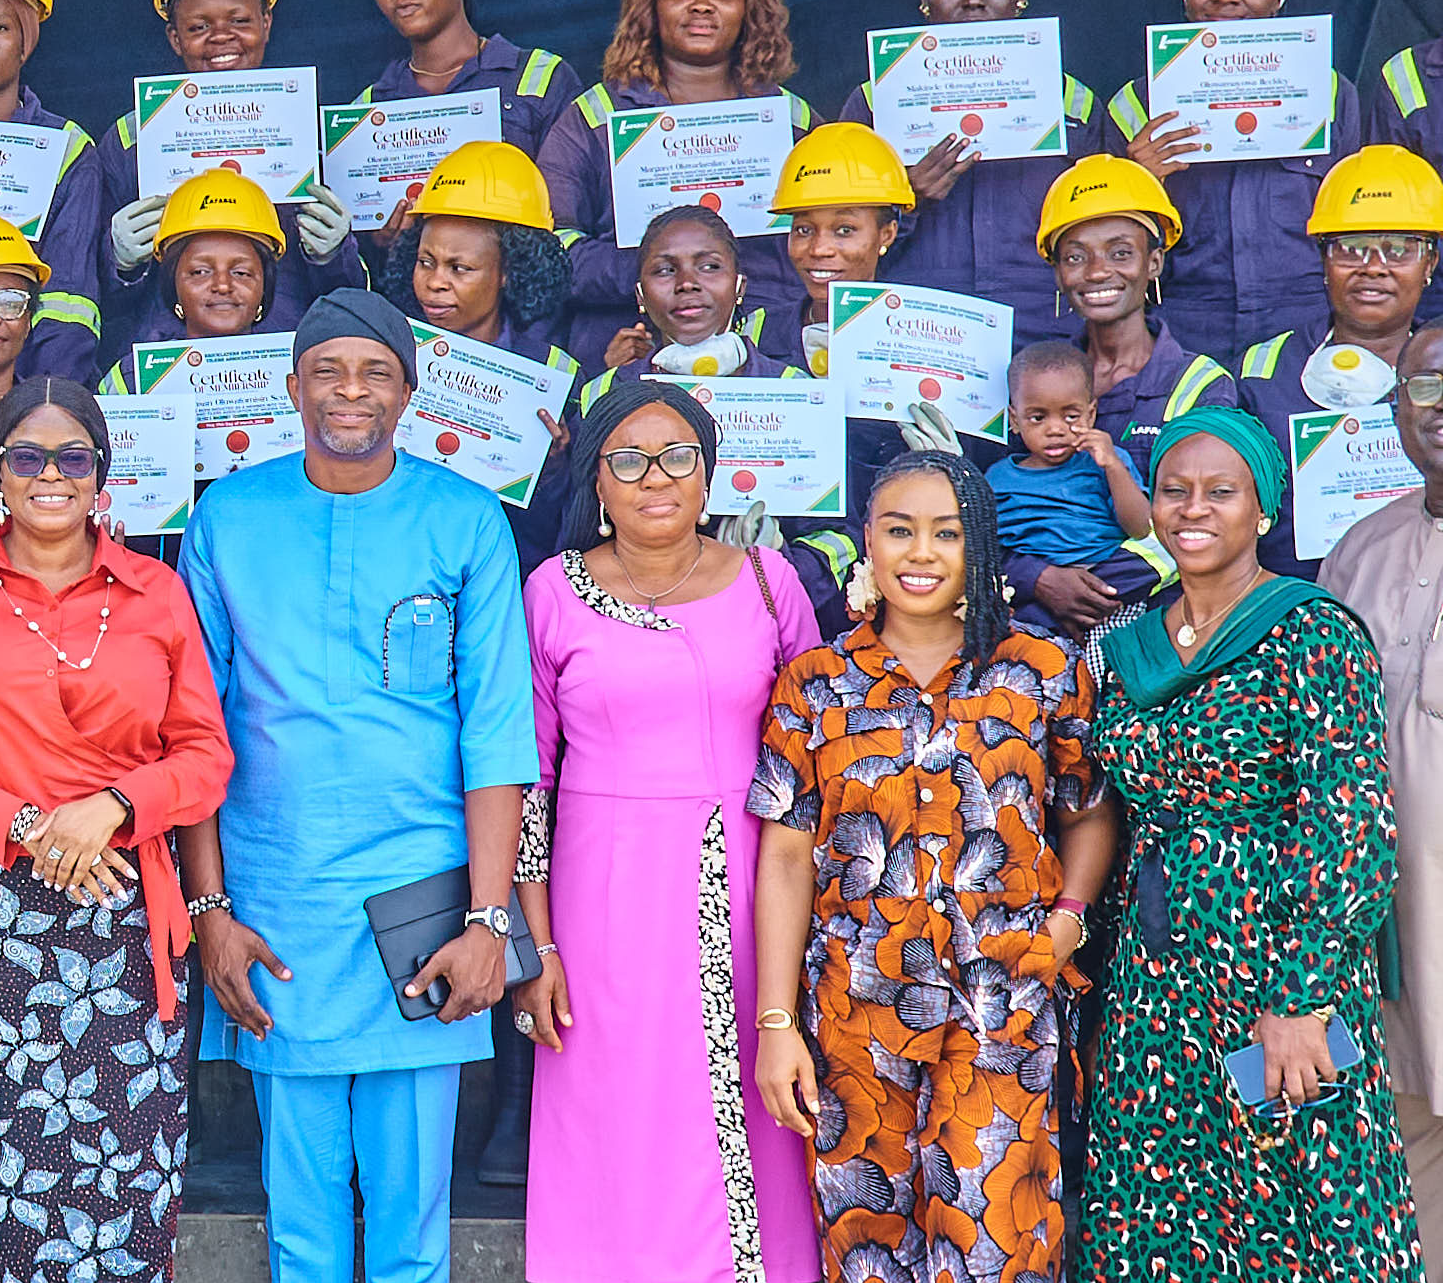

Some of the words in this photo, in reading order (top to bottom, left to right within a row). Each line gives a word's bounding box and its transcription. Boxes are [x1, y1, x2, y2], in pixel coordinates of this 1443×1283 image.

[925, 54, 1006, 70] Certificate
[1204, 51, 1283, 67] Certificate
[186, 101, 264, 116] Certificate
[205, 114, 261, 122] MEMBERSHIP
[373, 125, 450, 144] Certificate
[392, 137, 447, 148] MEMBERSHIP
[663, 132, 741, 150] Certificate
[794, 164, 831, 183] LAFARGE
[431, 174, 466, 192] LAFARGE
[1069, 182, 1108, 203] LAFARGE
[1349, 187, 1392, 205] LAFARGE
[199, 194, 237, 211] LAFARGE
[887, 314, 965, 339] Certificate
[190, 368, 271, 386] Certificate
[426, 361, 510, 399] Certificate
[210, 381, 269, 392] MEMBERSHIP
[442, 379, 501, 406] MEMBERSHIP
[716, 410, 786, 424] rtificate
